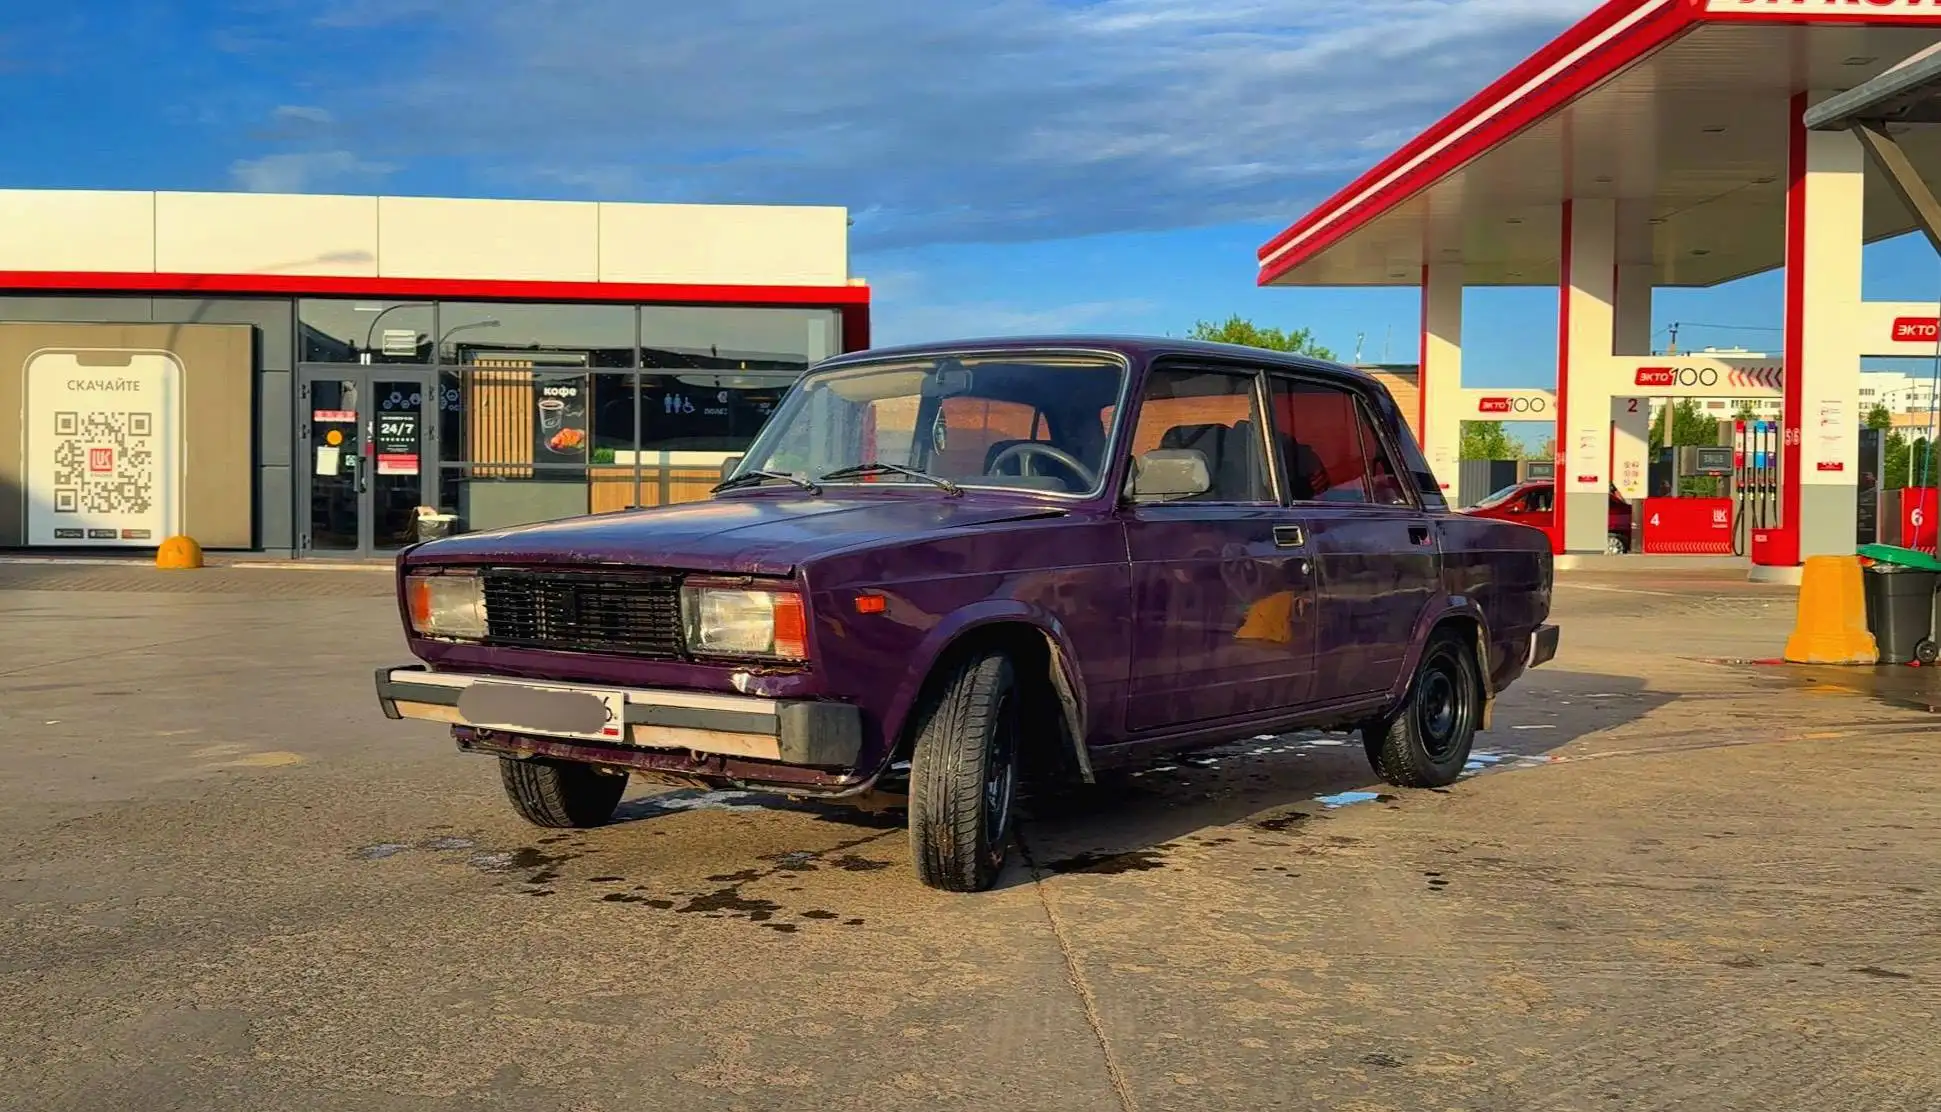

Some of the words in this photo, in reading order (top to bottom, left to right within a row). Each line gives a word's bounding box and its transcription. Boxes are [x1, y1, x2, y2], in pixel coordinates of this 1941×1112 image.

[1897, 324, 1936, 336] ЭКТО
[67, 378, 141, 392] СКАЧАЙТЕ
[1627, 398, 1638, 413] 2
[380, 422, 415, 436] 24/7
[1650, 513, 1660, 527] 4
[1911, 508, 1923, 527] 6
